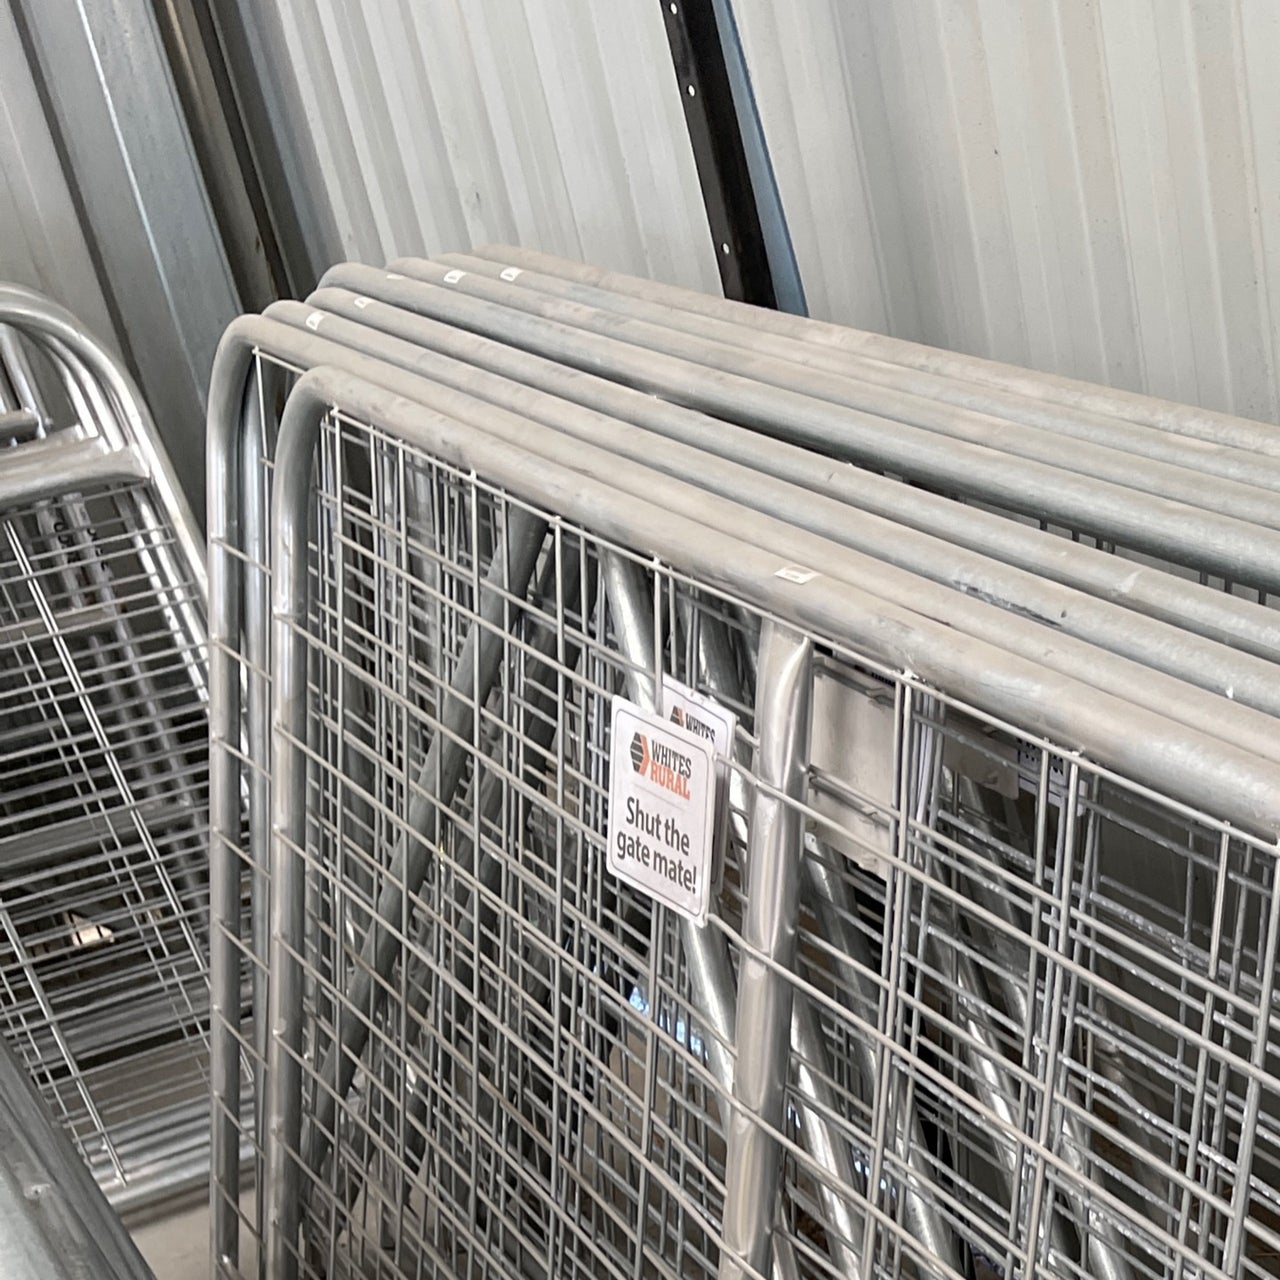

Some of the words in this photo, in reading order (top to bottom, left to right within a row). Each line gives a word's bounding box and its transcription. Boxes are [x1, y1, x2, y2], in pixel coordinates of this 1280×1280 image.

[685, 712, 716, 744] WHITES
[651, 739, 692, 779] WHITES
[650, 760, 691, 801] RURAL
[626, 796, 662, 841] Shut
[664, 817, 690, 856] the
[617, 830, 650, 868] gate
[653, 850, 697, 894] mate!
